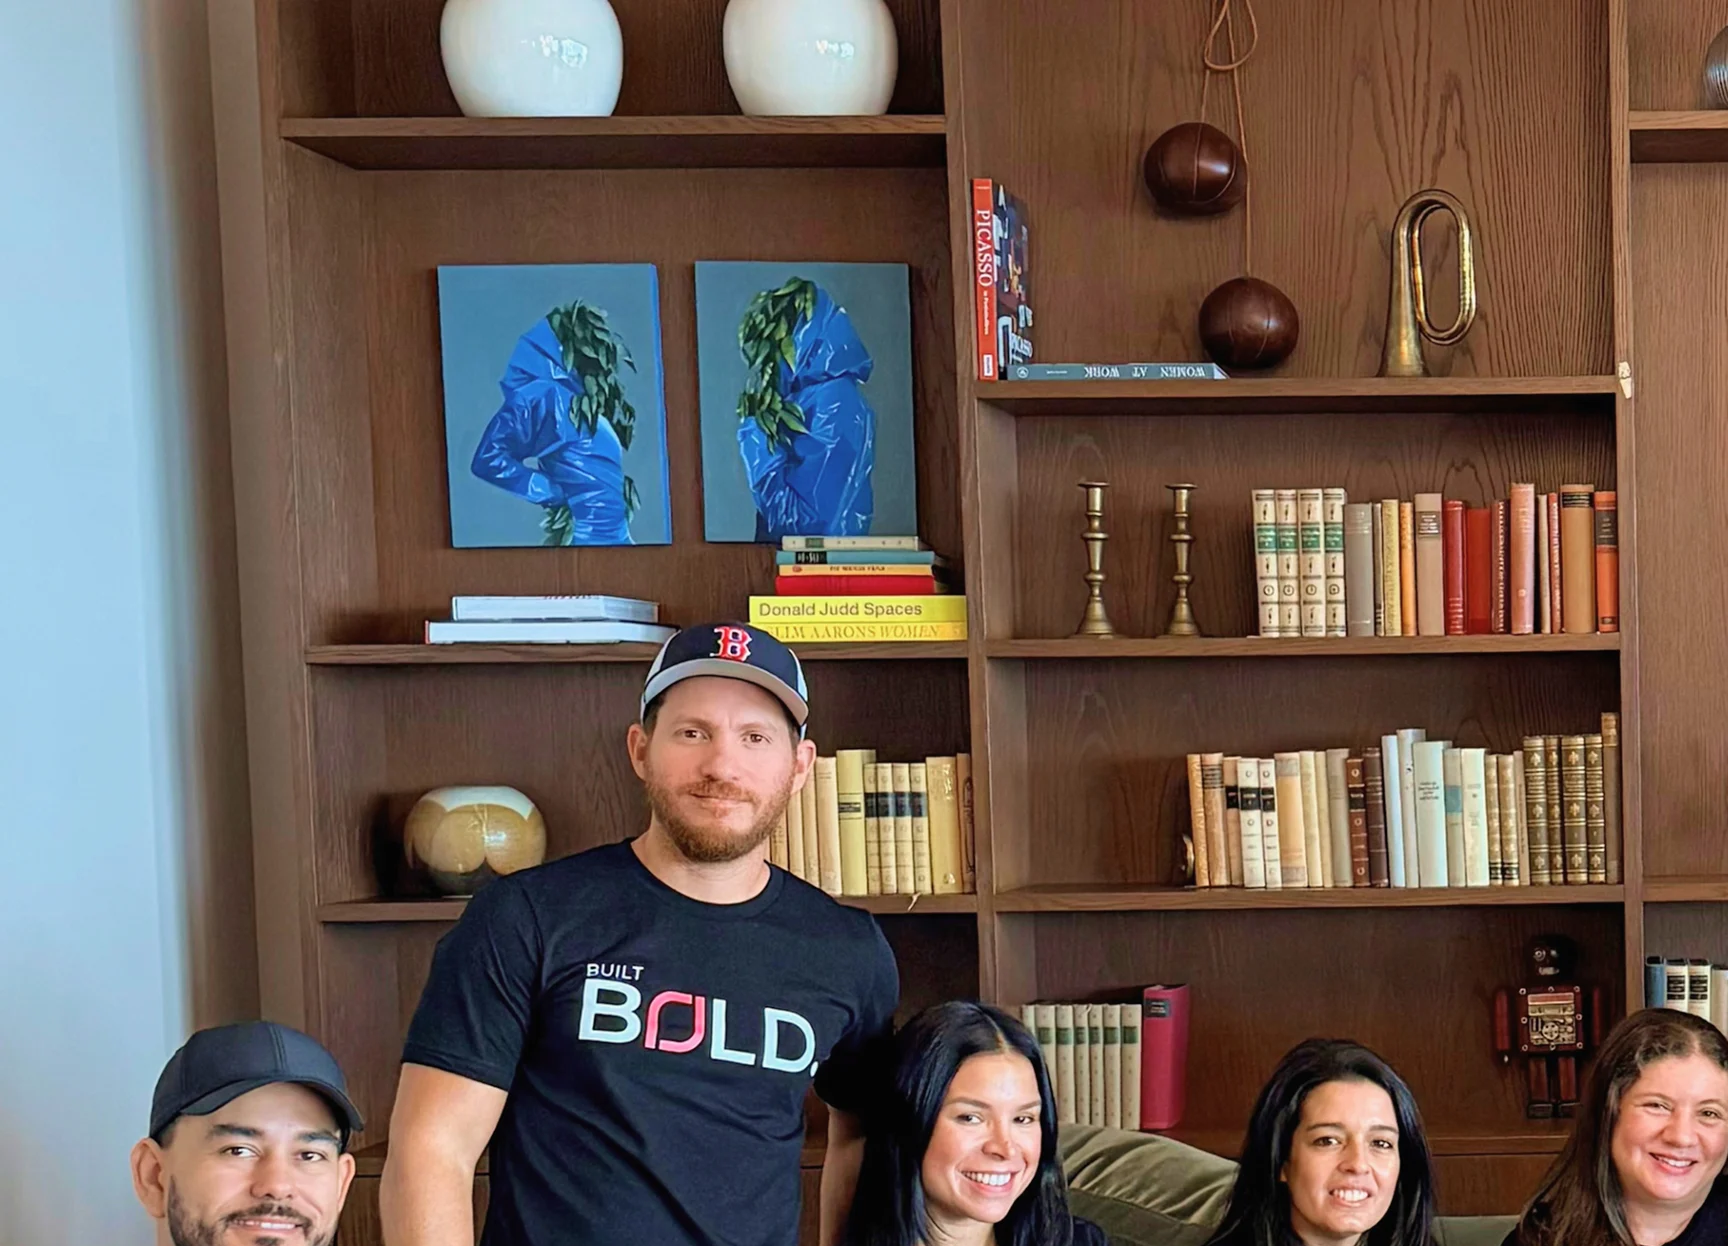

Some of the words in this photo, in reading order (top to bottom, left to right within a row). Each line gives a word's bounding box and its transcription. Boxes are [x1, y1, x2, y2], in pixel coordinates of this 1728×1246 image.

[976, 209, 993, 287] PICASSO
[1085, 367, 1120, 377] WORK
[1132, 367, 1148, 377] AT
[1161, 367, 1205, 377] WOMEN
[759, 602, 815, 616] Donald
[819, 602, 859, 616] Judd
[864, 602, 923, 620] Spaces
[810, 626, 876, 639] AARONS
[879, 625, 939, 638] WOMEN
[710, 626, 752, 661] B
[586, 963, 645, 981] BUILT
[578, 978, 819, 1079] BOLD.
